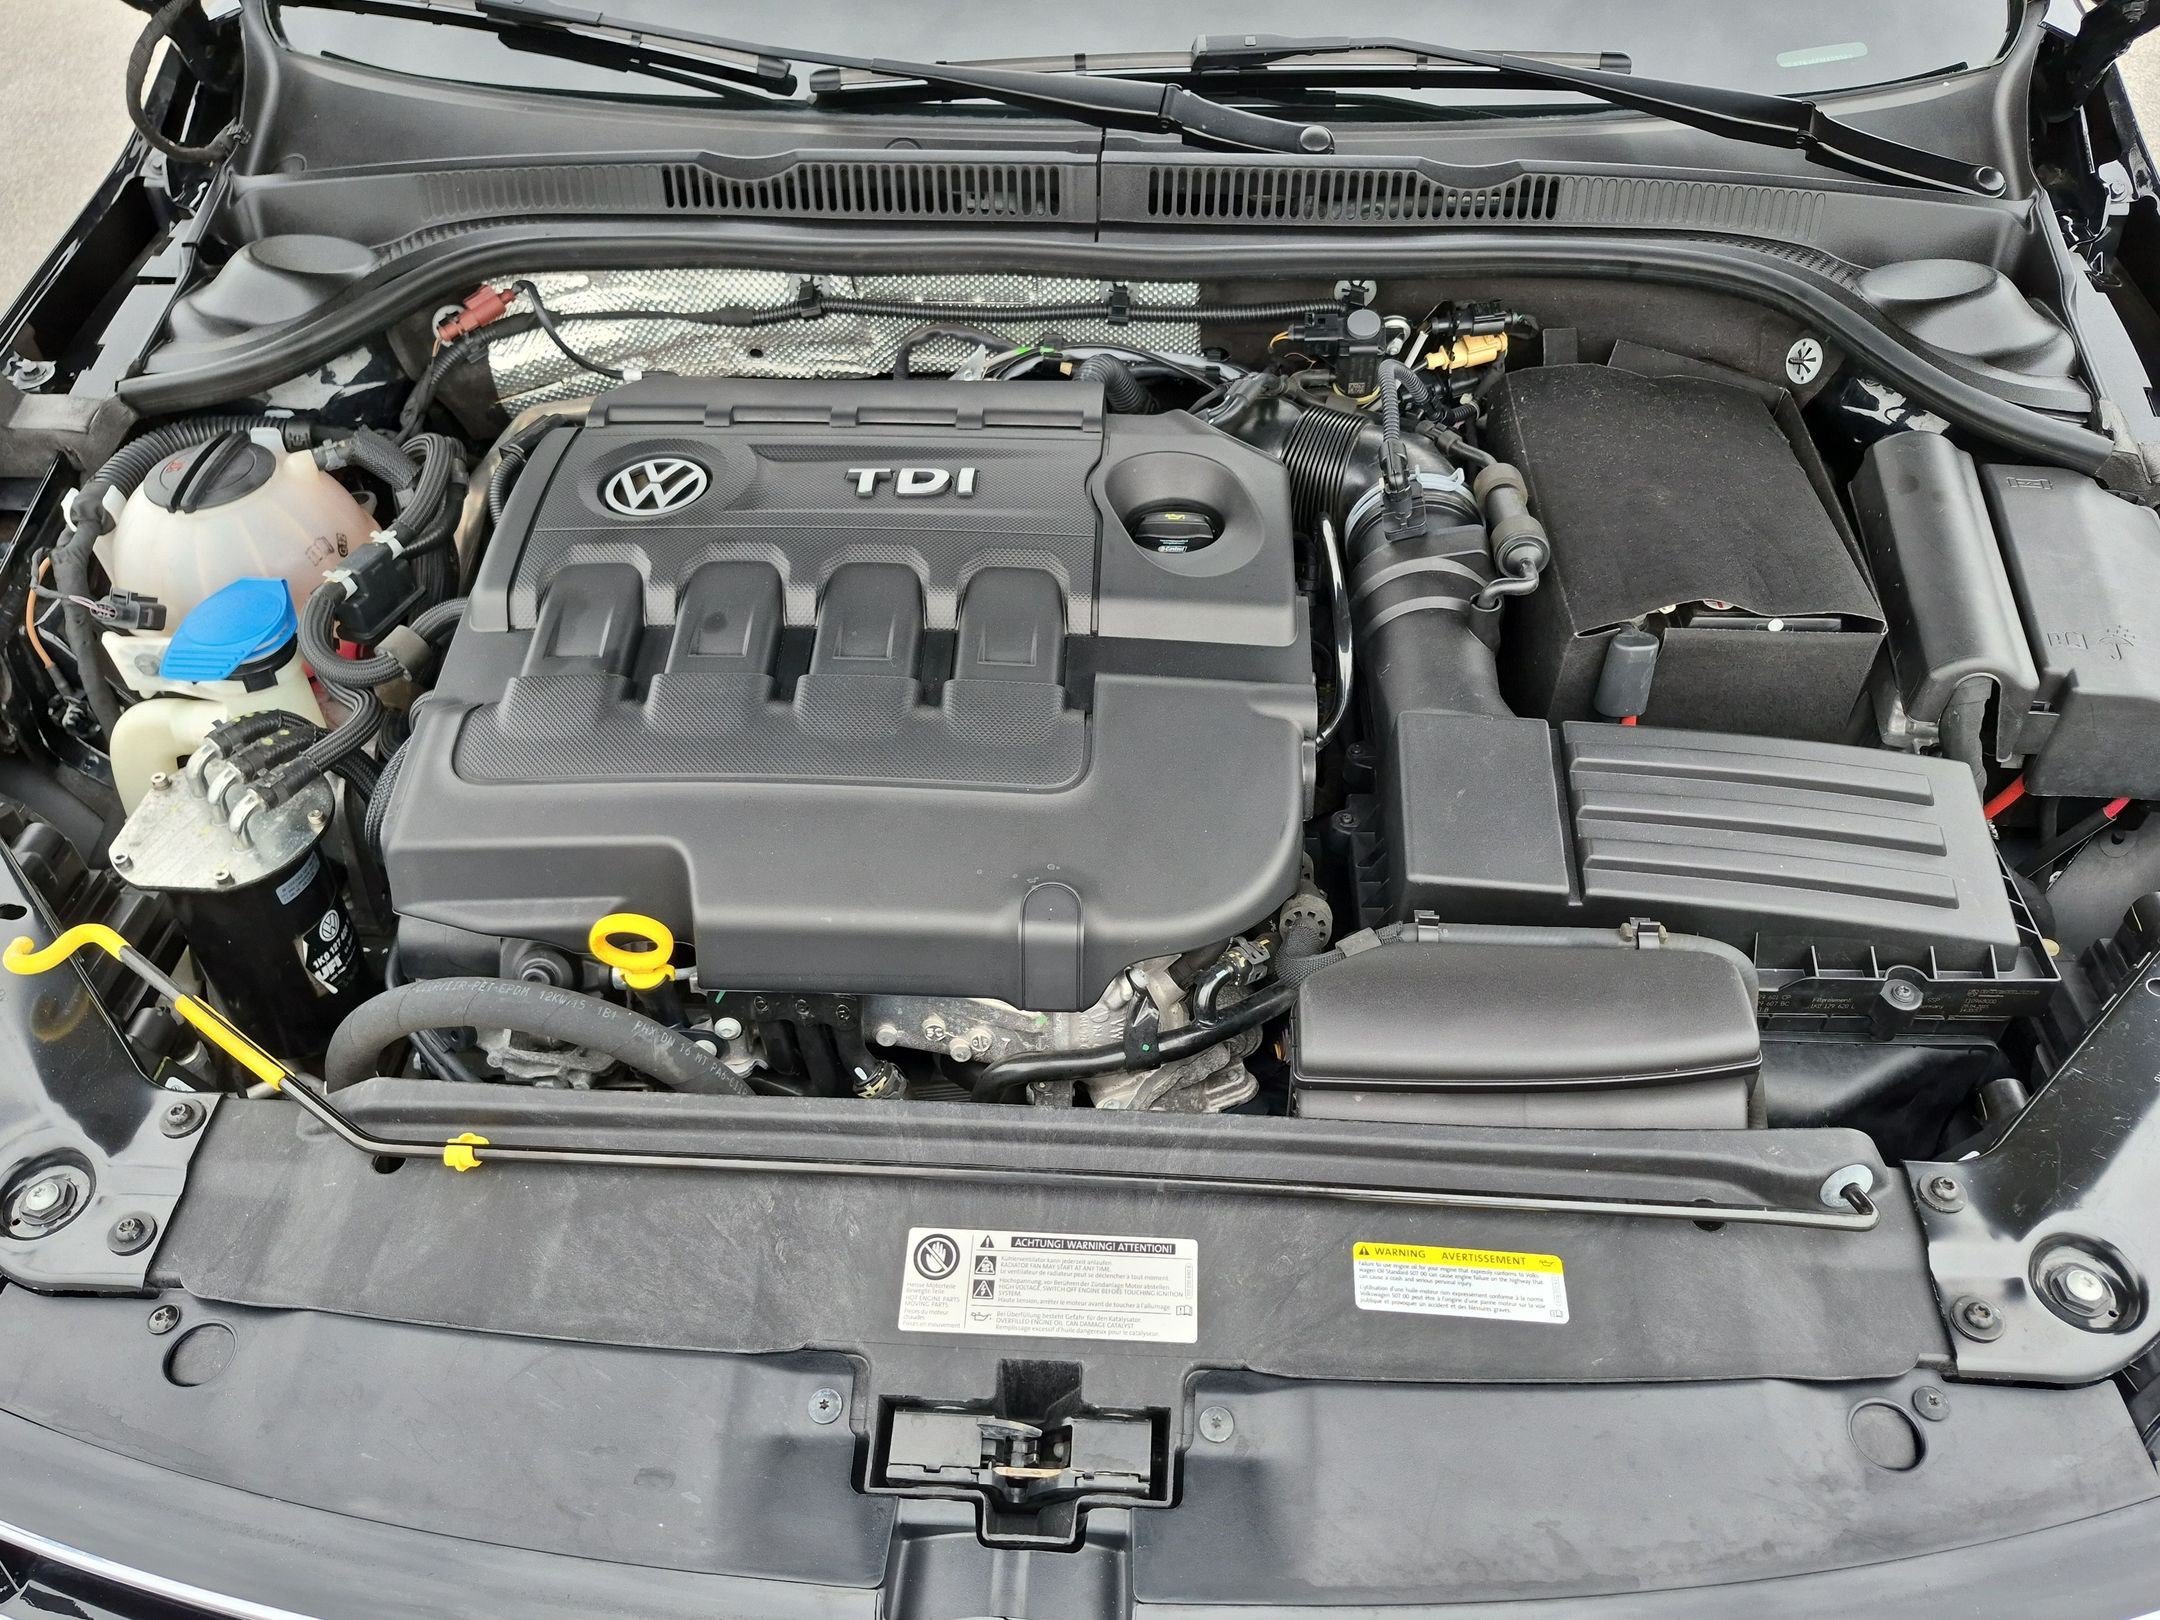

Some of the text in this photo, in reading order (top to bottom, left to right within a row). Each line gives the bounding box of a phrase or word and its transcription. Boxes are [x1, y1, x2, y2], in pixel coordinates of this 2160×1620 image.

[845, 466, 977, 497] TDI
[679, 1043, 691, 1057] 16
[1014, 1238, 1173, 1254] ACHTUNG! WARNING! ATTENTION!
[1374, 1247, 1526, 1266] WARNING AVERTISSEMENT
[1124, 1288, 1155, 1296] TOUCHING
